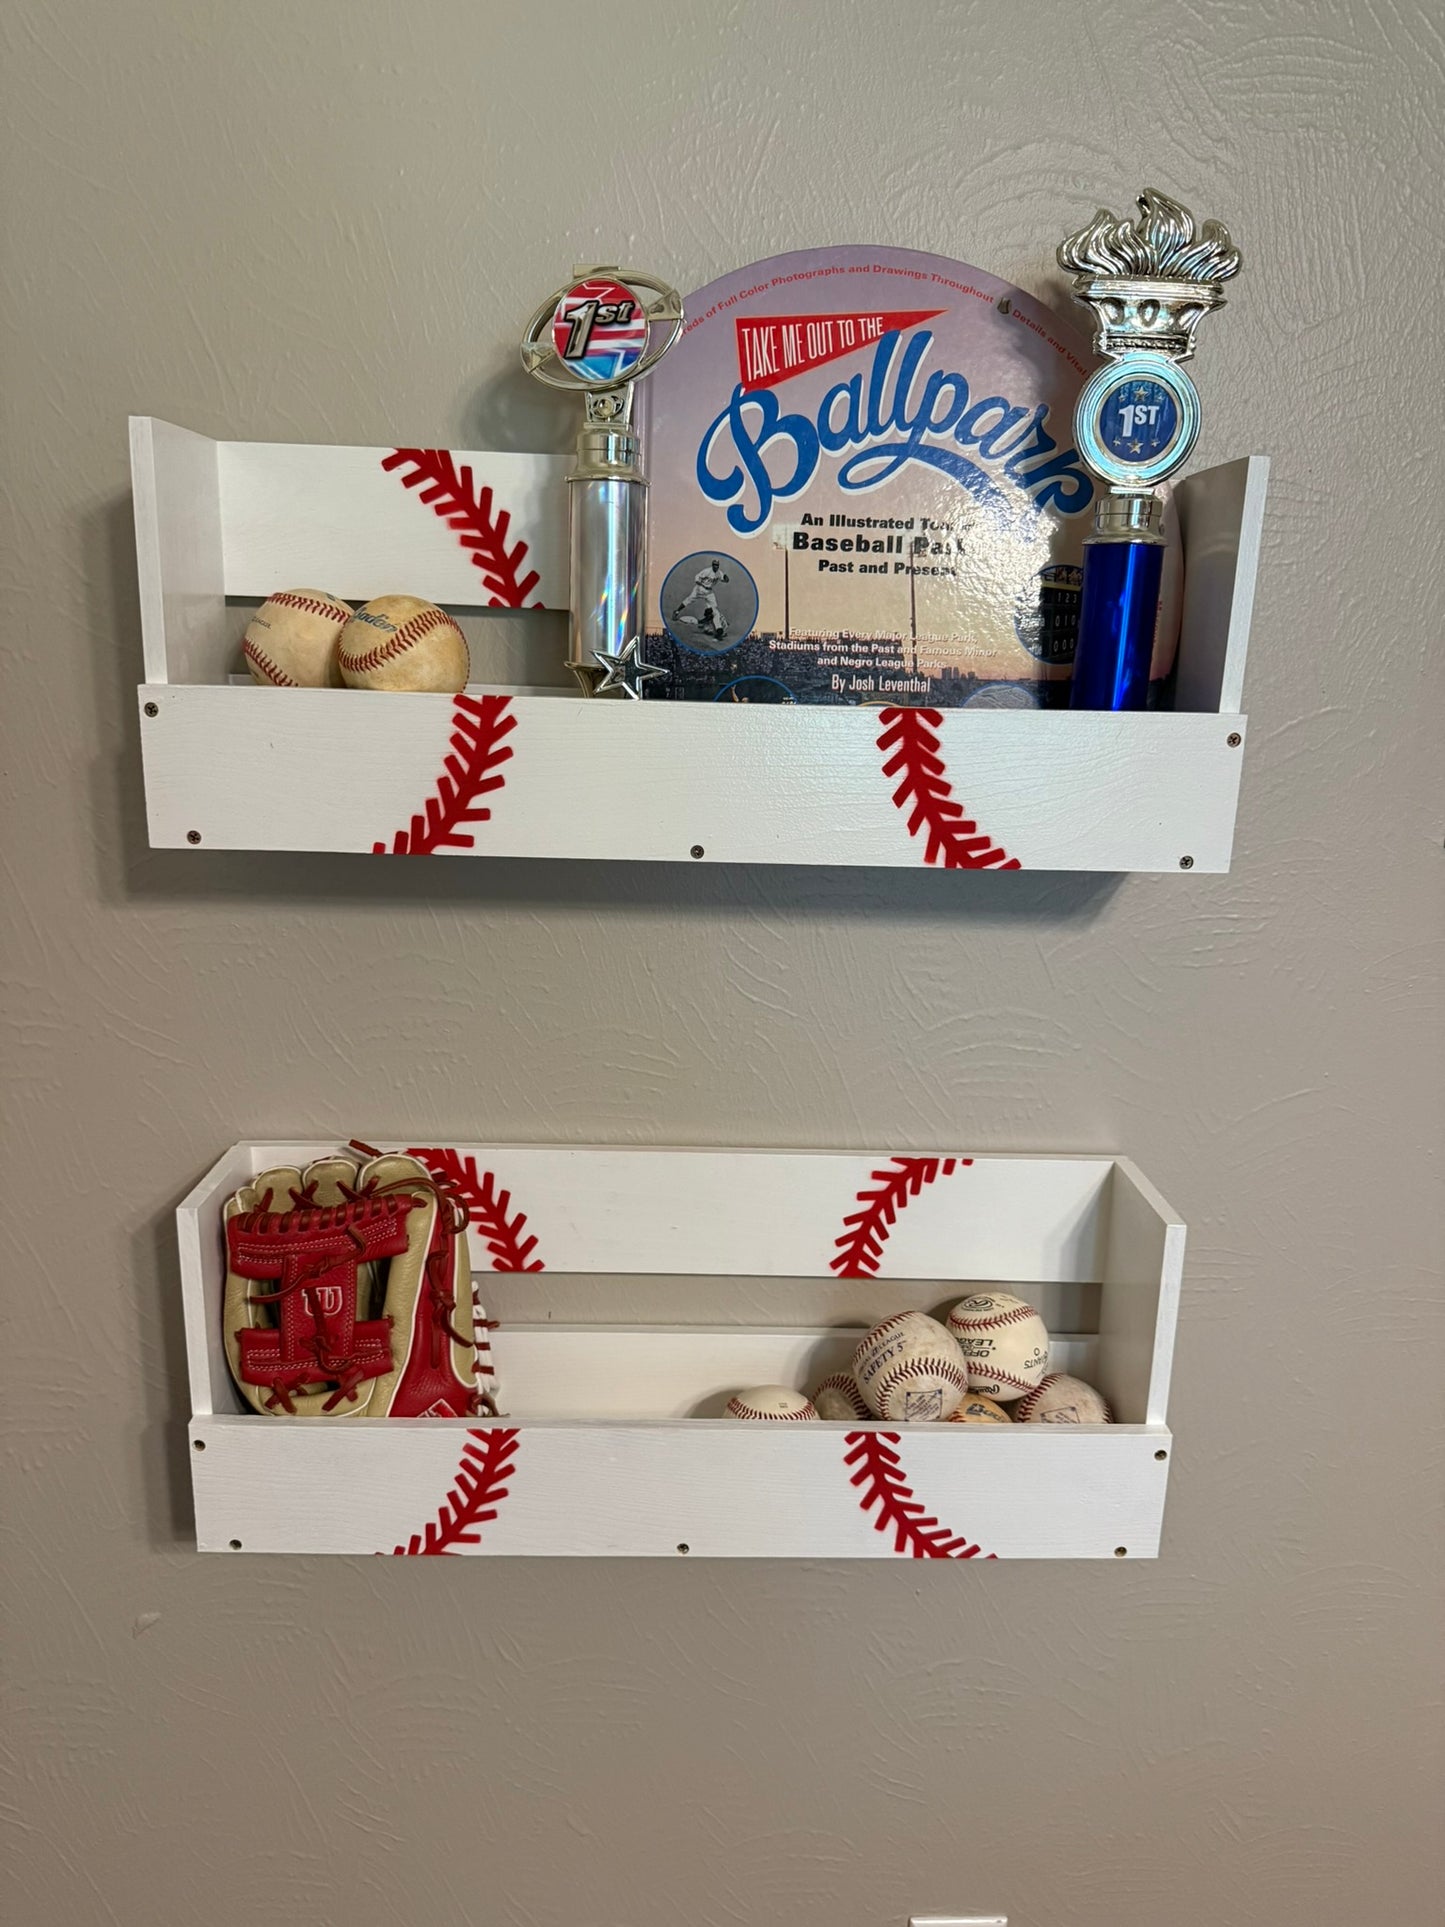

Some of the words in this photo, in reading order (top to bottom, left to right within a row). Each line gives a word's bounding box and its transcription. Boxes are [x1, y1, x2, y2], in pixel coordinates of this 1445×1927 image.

[682, 316, 705, 337] reds
[706, 305, 716, 318] of
[717, 294, 738, 310] Full
[739, 282, 769, 300] Color
[771, 265, 846, 287] Photographs
[848, 264, 870, 274] and
[873, 264, 928, 280] Drawings
[931, 272, 994, 304] Throughout
[563, 300, 636, 360] 1st
[1012, 309, 1046, 338] Details
[1047, 336, 1066, 354] and
[1066, 352, 1087, 376] Vital
[742, 326, 780, 382] TAKE
[782, 323, 805, 369] ME
[806, 321, 833, 360] OUT
[837, 319, 855, 349] TO
[858, 316, 885, 341] THE
[696, 329, 1096, 537] Ballpark
[1118, 404, 1160, 437] 1ST
[801, 513, 823, 527] An
[829, 514, 915, 530] Illustrated
[793, 532, 903, 554] Baseball
[818, 560, 853, 573] Past
[859, 562, 888, 574] and
[769, 640, 820, 652] Stadiums
[822, 641, 849, 652] from
[851, 642, 869, 653] the
[871, 643, 895, 654] Past
[896, 643, 917, 655] and
[920, 645, 962, 656] Famous
[964, 646, 998, 657] Minor
[789, 628, 840, 640] Featuring
[842, 629, 873, 641] Every
[874, 629, 908, 641] Major
[910, 632, 948, 643] League
[817, 656, 838, 666] and
[840, 656, 873, 668] Negro
[875, 657, 914, 669] League
[832, 674, 846, 693] By
[849, 674, 875, 691] Josh
[879, 675, 931, 693] Leventhal
[864, 1346, 895, 1384] SAFETY
